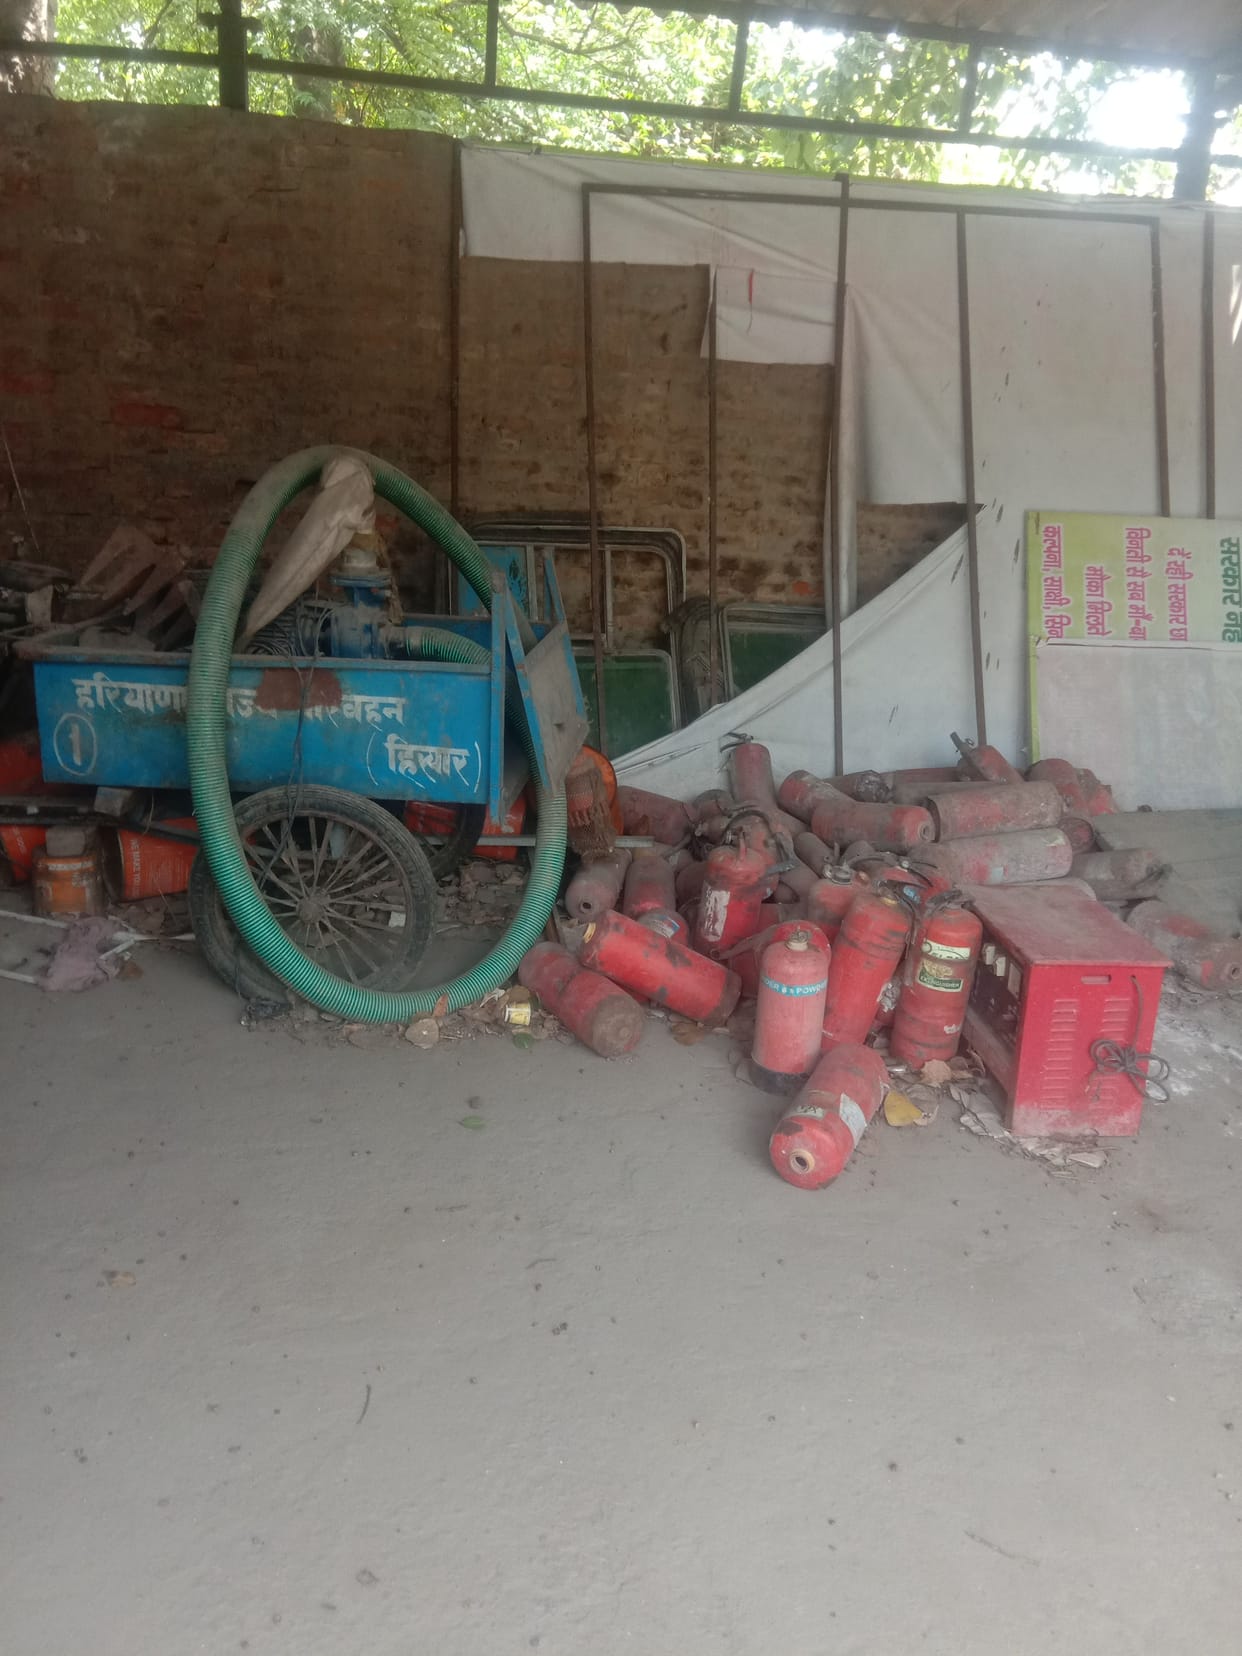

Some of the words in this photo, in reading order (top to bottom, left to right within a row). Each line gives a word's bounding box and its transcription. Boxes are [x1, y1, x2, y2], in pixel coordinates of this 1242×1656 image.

[1126, 527, 1153, 563] विनती
[1165, 560, 1194, 581] रही
[1221, 537, 1242, 608] सरकार
[1127, 581, 1146, 602] सब
[1168, 584, 1187, 625] सरकार
[1086, 600, 1113, 636] मिलते
[71, 672, 188, 715] हरियाणा
